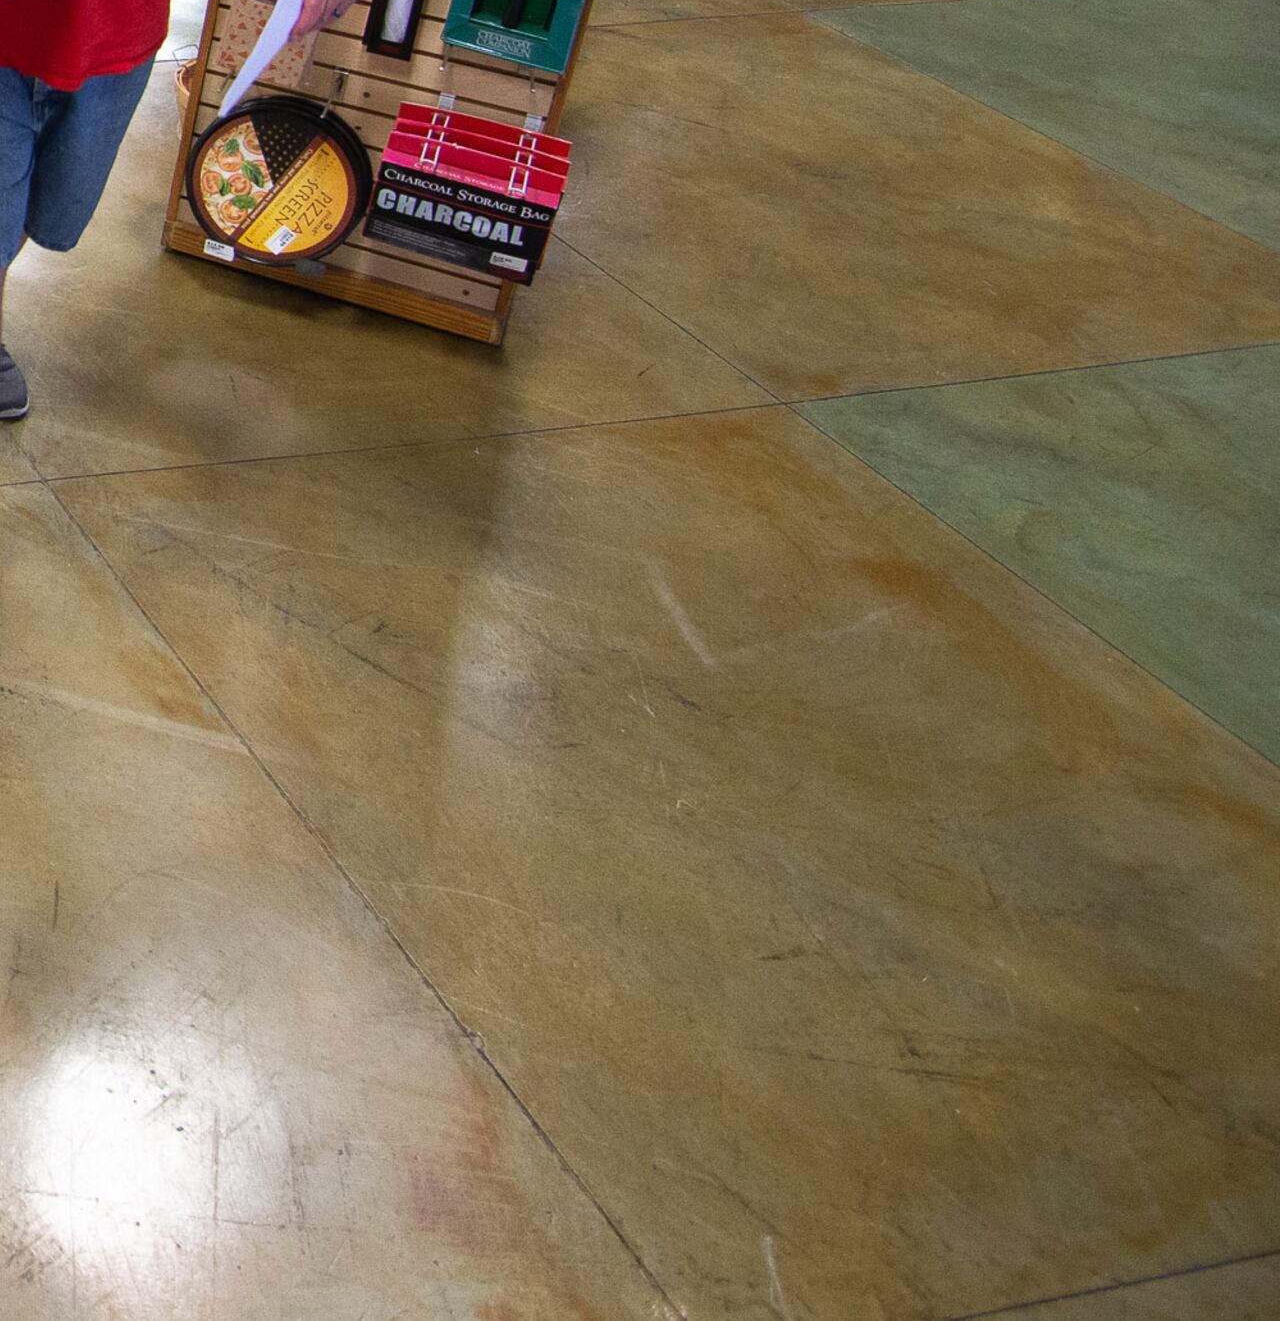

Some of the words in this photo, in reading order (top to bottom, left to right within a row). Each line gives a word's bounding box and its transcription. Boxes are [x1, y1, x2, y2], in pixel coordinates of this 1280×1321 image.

[273, 178, 319, 228] SCREEN
[289, 191, 333, 238] PIZZA
[376, 188, 524, 246] CHARCOAL
[384, 168, 454, 196] CHARCOAL
[457, 189, 517, 214] STORAGE
[520, 206, 550, 222] BAG
